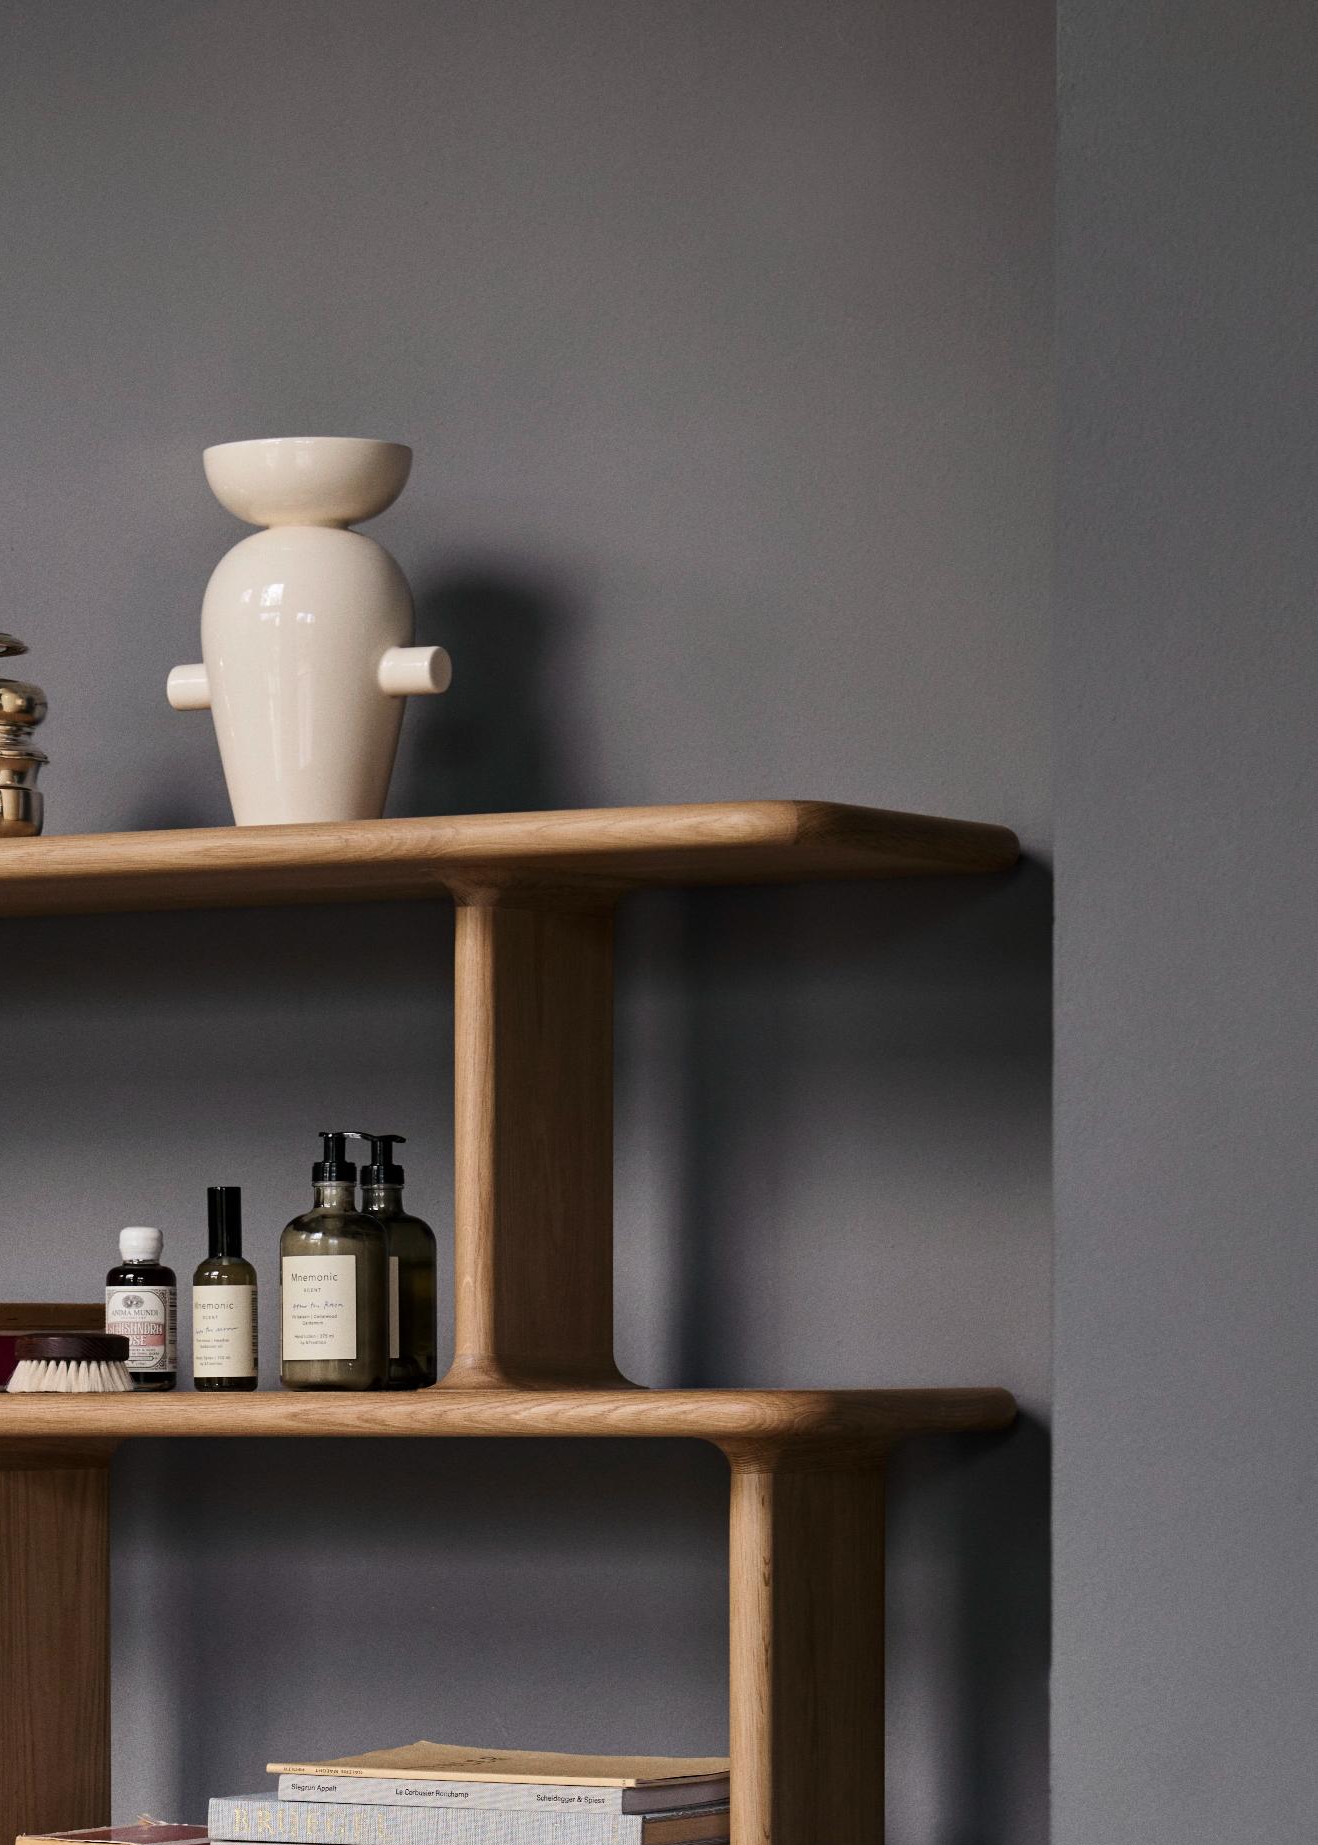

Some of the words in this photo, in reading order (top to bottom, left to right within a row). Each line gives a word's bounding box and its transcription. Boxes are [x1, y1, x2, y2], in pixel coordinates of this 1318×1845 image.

[291, 1273, 338, 1282] Mnemonic
[129, 1335, 147, 1346] OSE
[291, 1783, 316, 1792] Siegrun
[317, 1784, 337, 1793] Appelt
[395, 1788, 404, 1796] Le
[405, 1789, 434, 1797] Corbusier
[435, 1790, 469, 1799] Ronchamp
[536, 1794, 575, 1804] Scheidegger
[584, 1796, 605, 1804] Spiess
[234, 1807, 395, 1841] BRUEGEL
